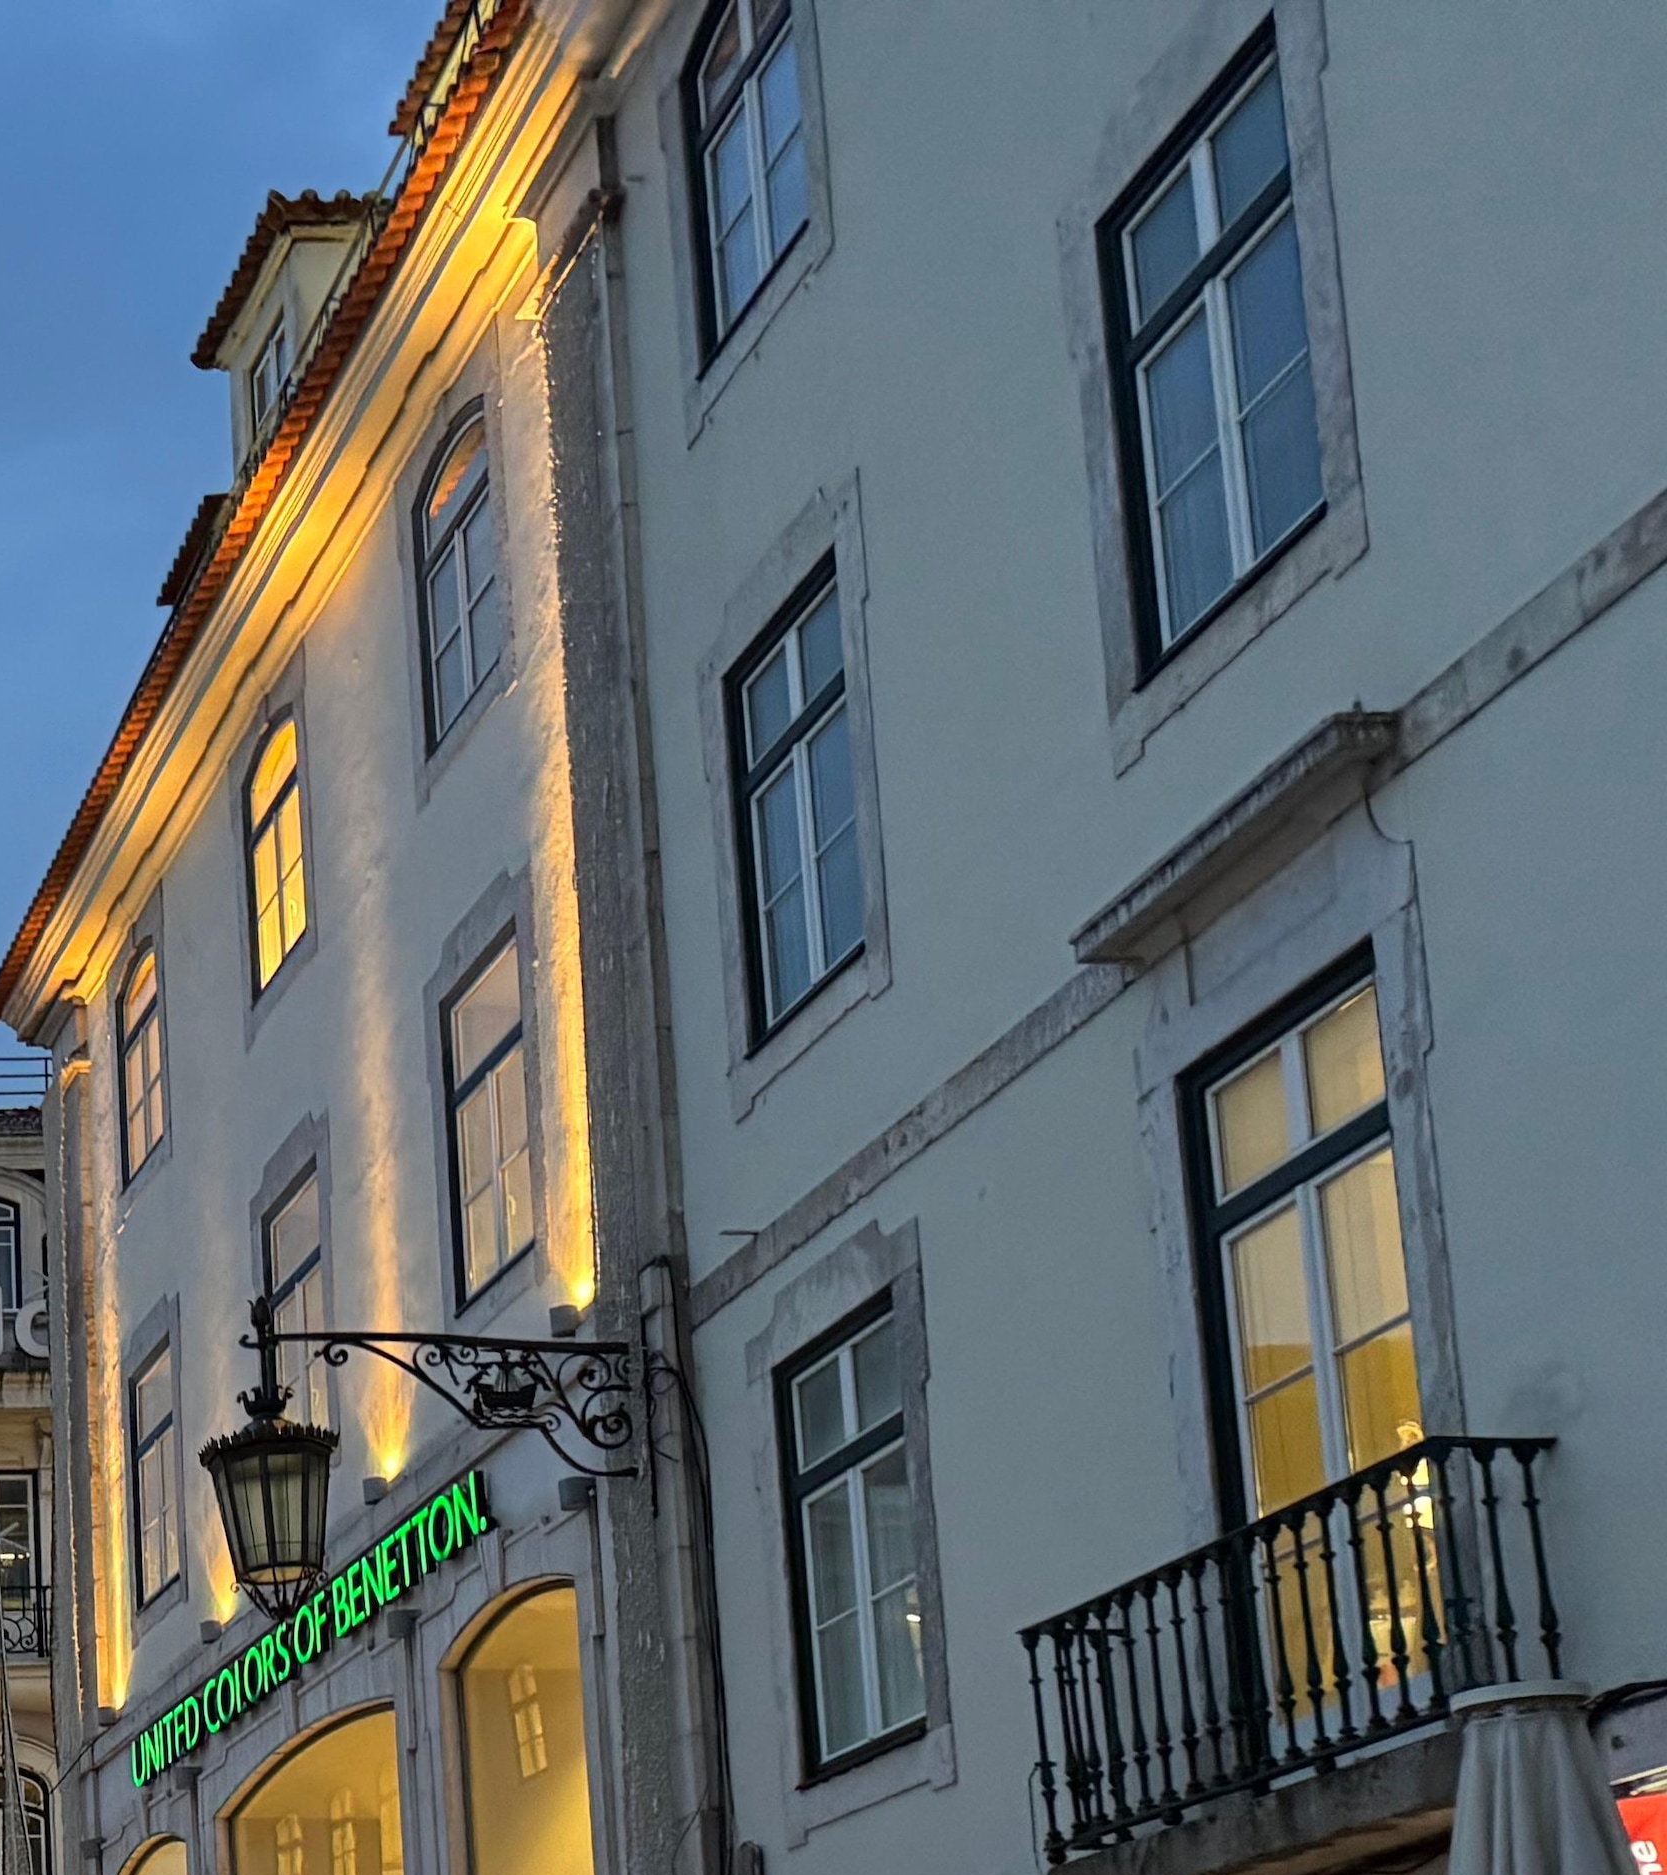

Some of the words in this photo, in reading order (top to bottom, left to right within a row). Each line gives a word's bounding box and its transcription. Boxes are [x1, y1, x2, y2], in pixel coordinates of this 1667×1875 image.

[130, 1695, 199, 1788] UNITED
[203, 1622, 291, 1734] COLORS
[291, 1593, 328, 1664] OF
